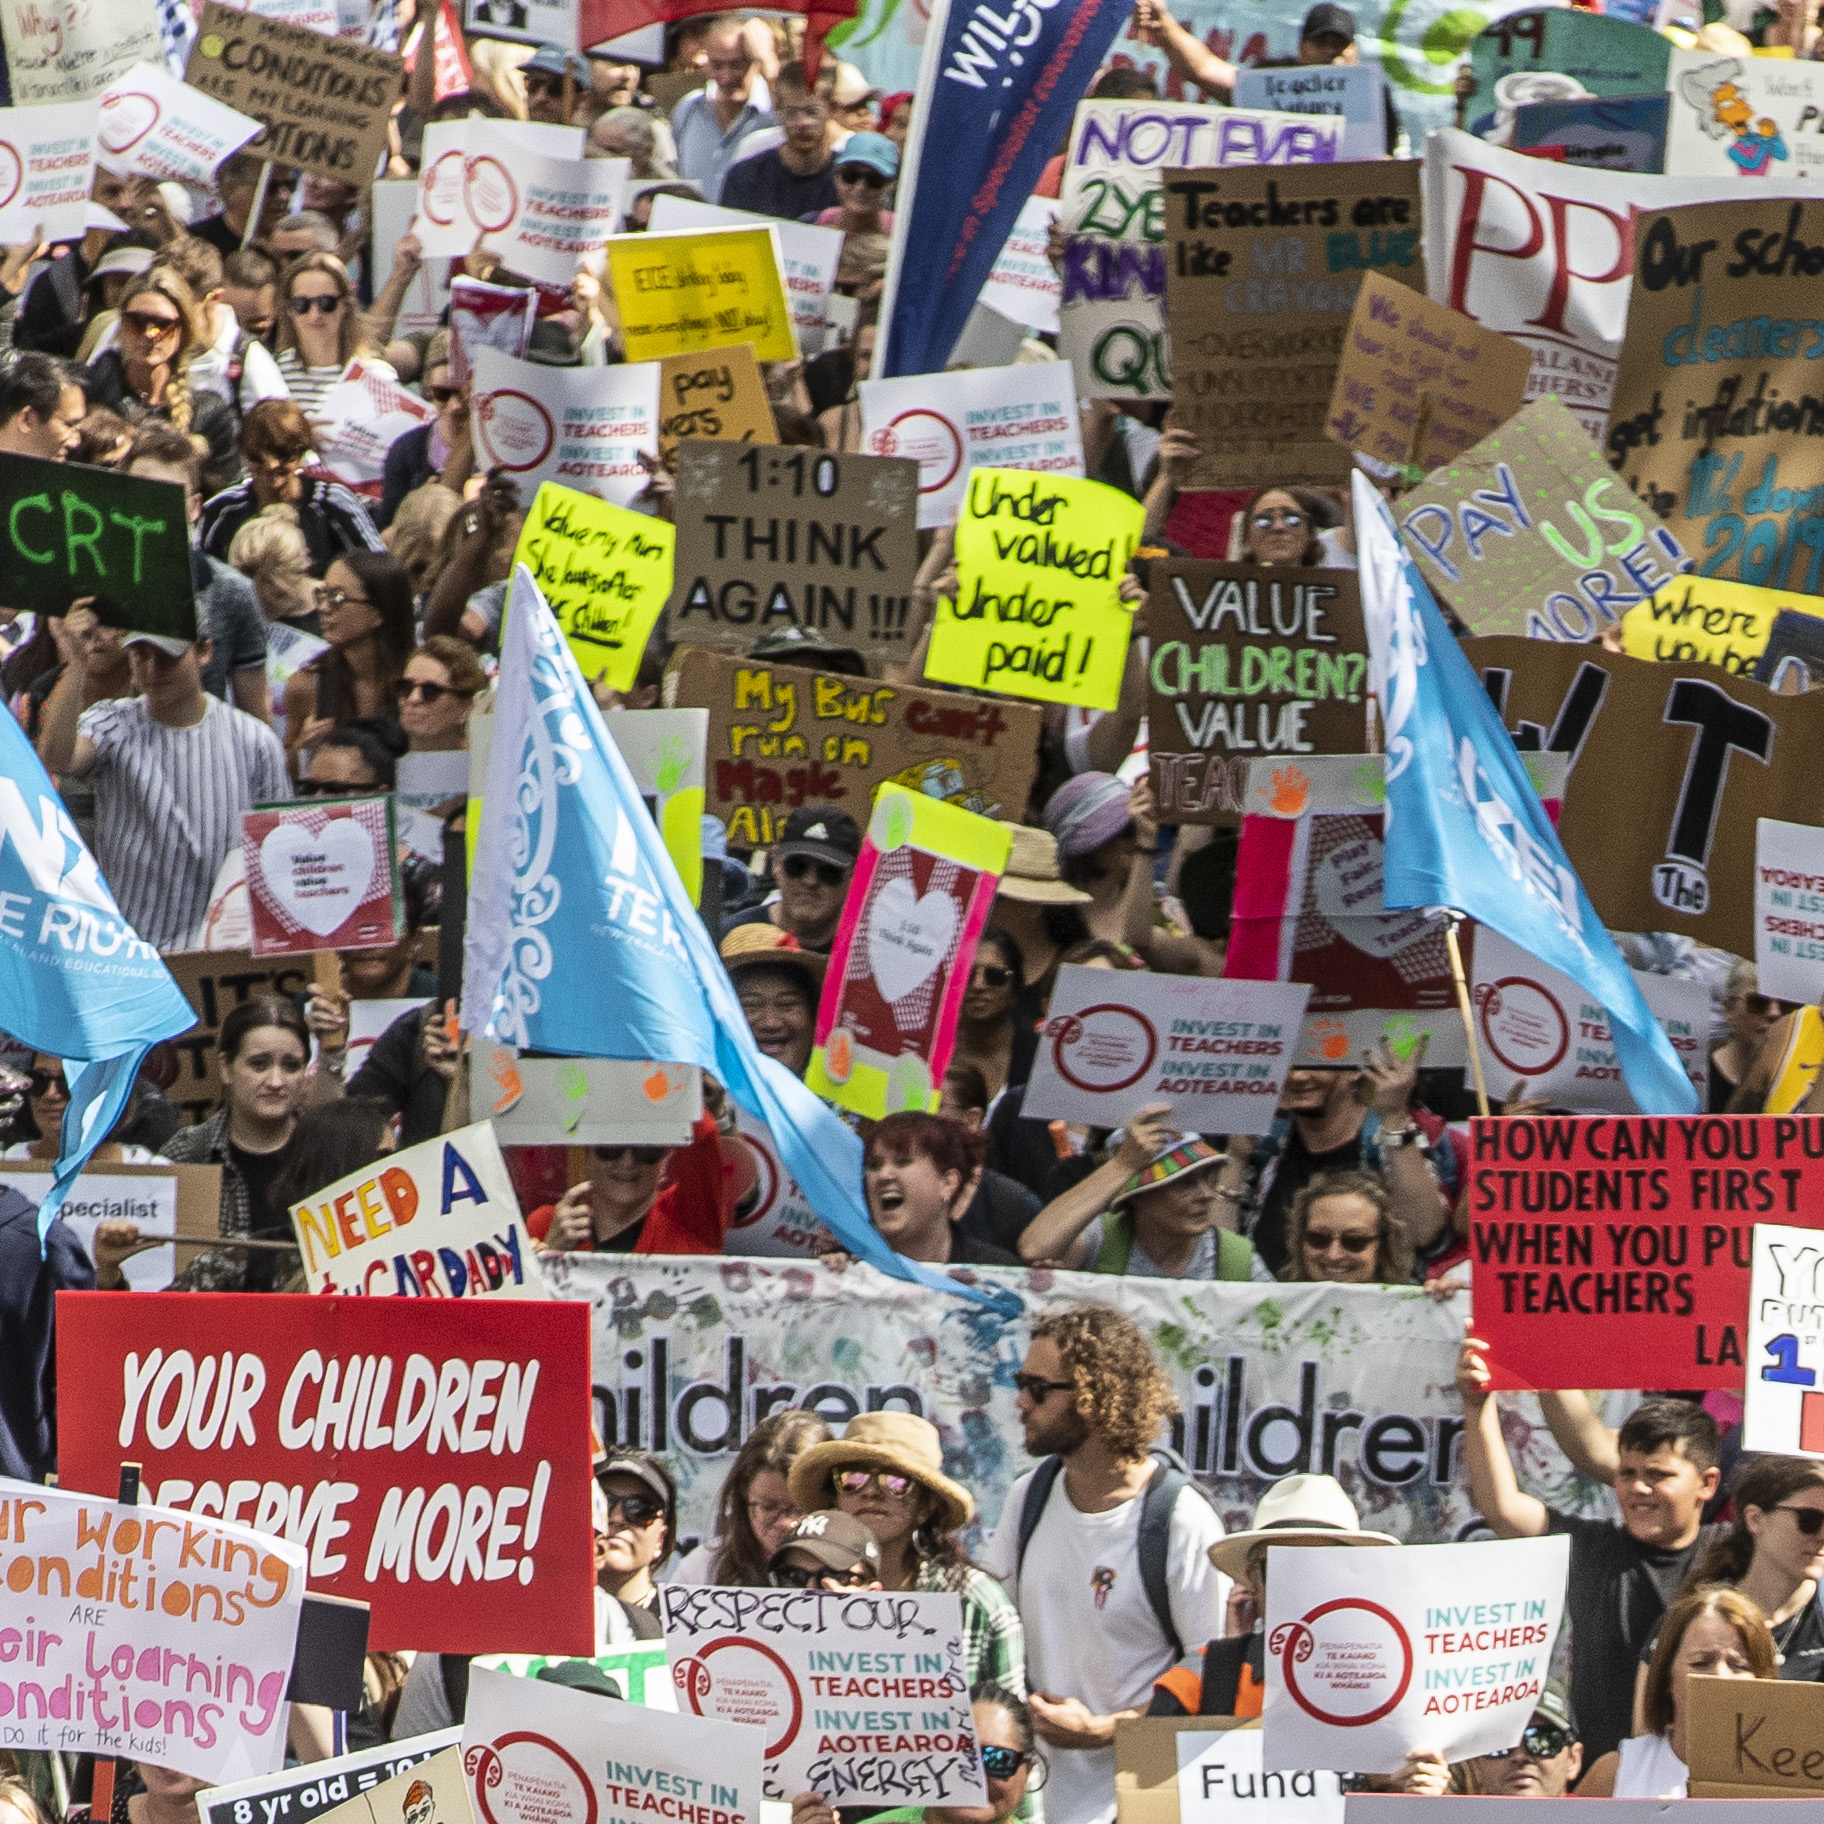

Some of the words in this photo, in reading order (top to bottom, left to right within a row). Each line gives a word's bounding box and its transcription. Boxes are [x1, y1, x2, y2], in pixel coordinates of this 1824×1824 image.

[738, 453, 840, 497] 1:10
[971, 479, 1071, 523] Under
[9, 491, 165, 586] CRT
[705, 518, 888, 570] THINK
[995, 523, 1134, 583] valued!
[679, 575, 855, 629] AGAIN
[948, 583, 1074, 627] Under
[1171, 575, 1338, 642] VALUE
[983, 640, 1091, 684] paid!
[1151, 642, 1366, 704] CHILDREN?
[1173, 703, 1316, 753] VALUE
[1169, 1035, 1282, 1057] TEACHERS
[1171, 1020, 1253, 1040] INVEST
[1260, 1022, 1282, 1039] IN
[1156, 1077, 1279, 1096] AOTEAROA
[1161, 1062, 1246, 1082] INVEST
[1249, 1064, 1271, 1080] IN
